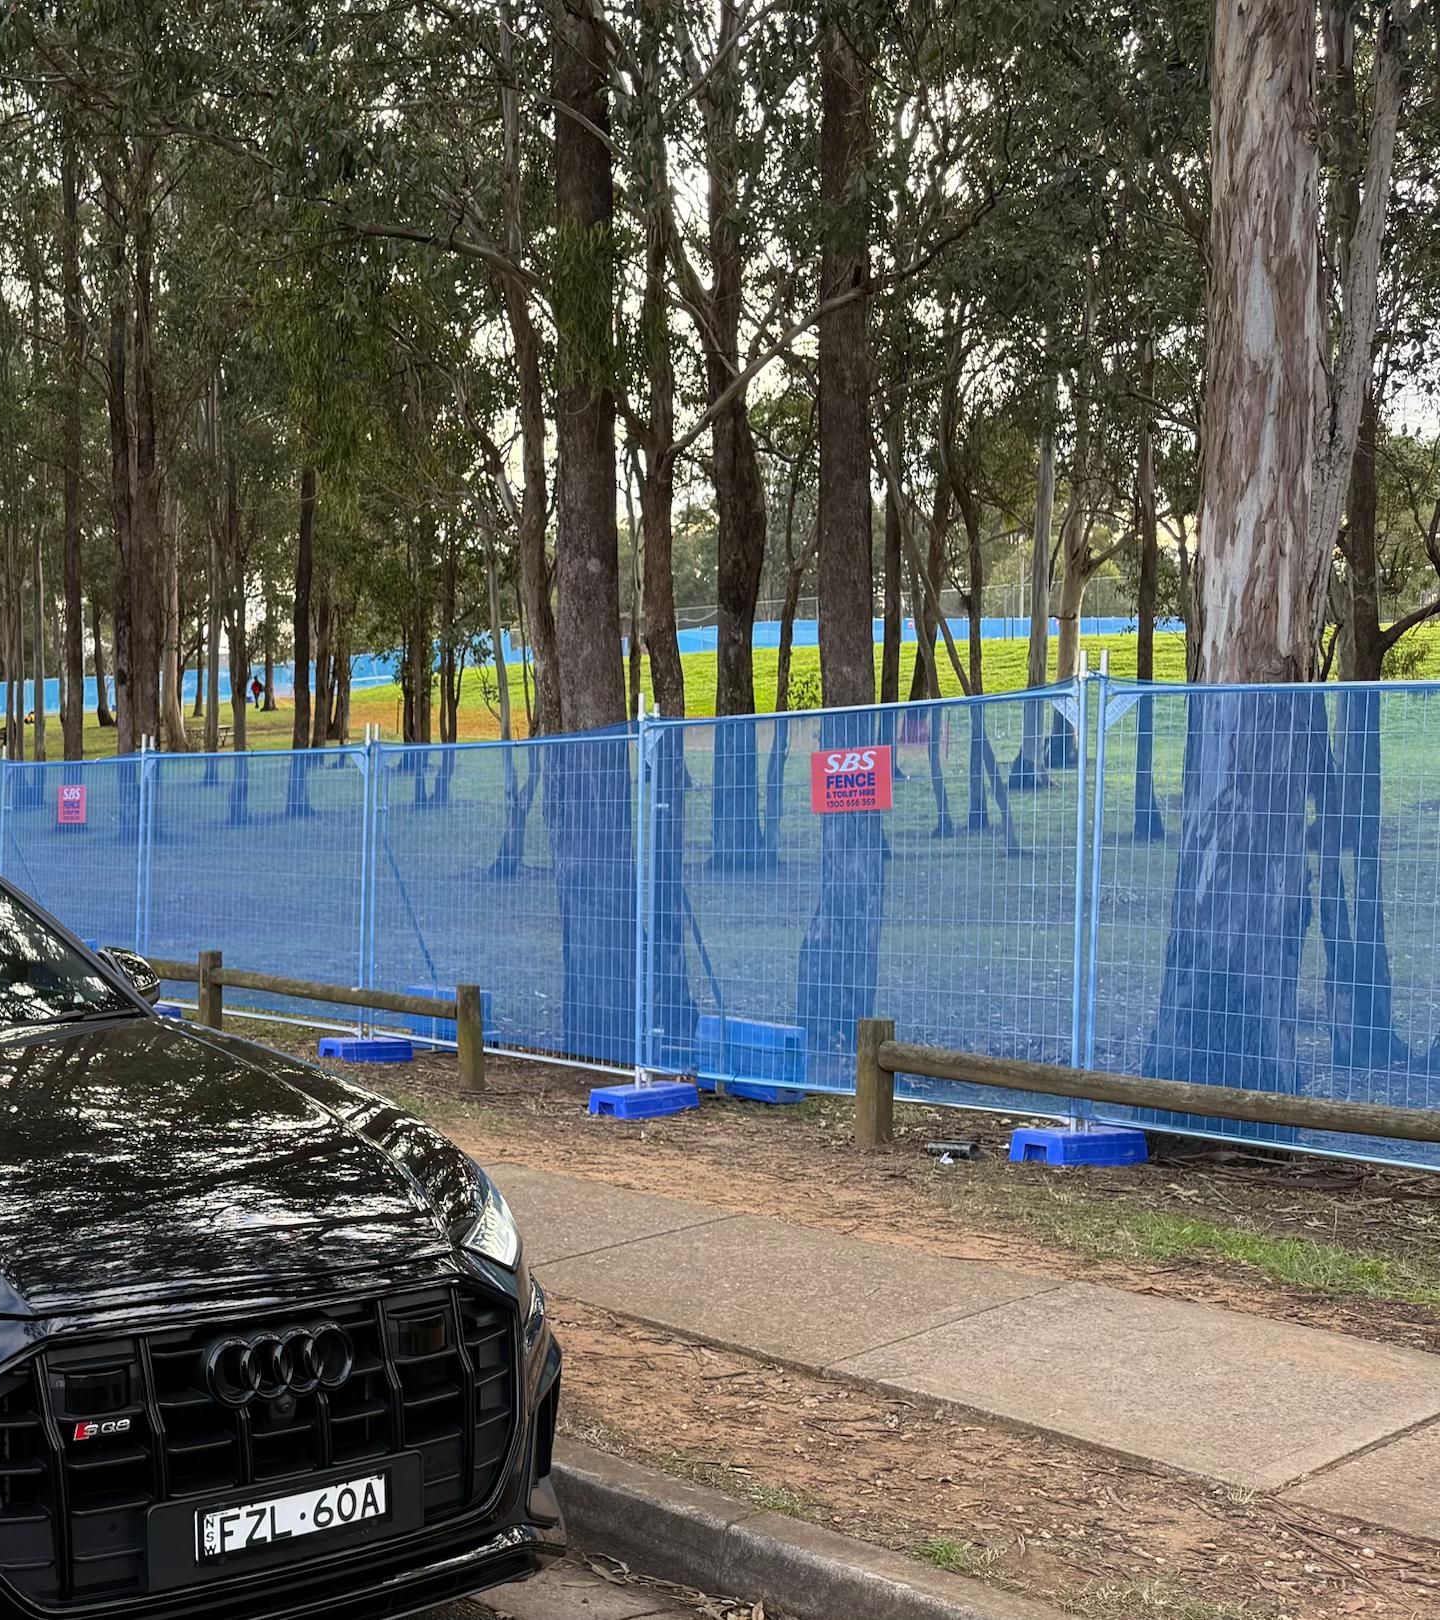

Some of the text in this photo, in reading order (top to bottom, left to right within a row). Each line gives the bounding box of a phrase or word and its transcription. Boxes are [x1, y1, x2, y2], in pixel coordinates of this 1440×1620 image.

[824, 751, 877, 773] SBS
[826, 772, 876, 790] FENCE
[63, 788, 80, 800] SBS
[833, 789, 858, 799] TOILET
[859, 788, 876, 797] HIRE
[826, 800, 845, 808] 1300
[83, 1419, 131, 1437] SQ8
